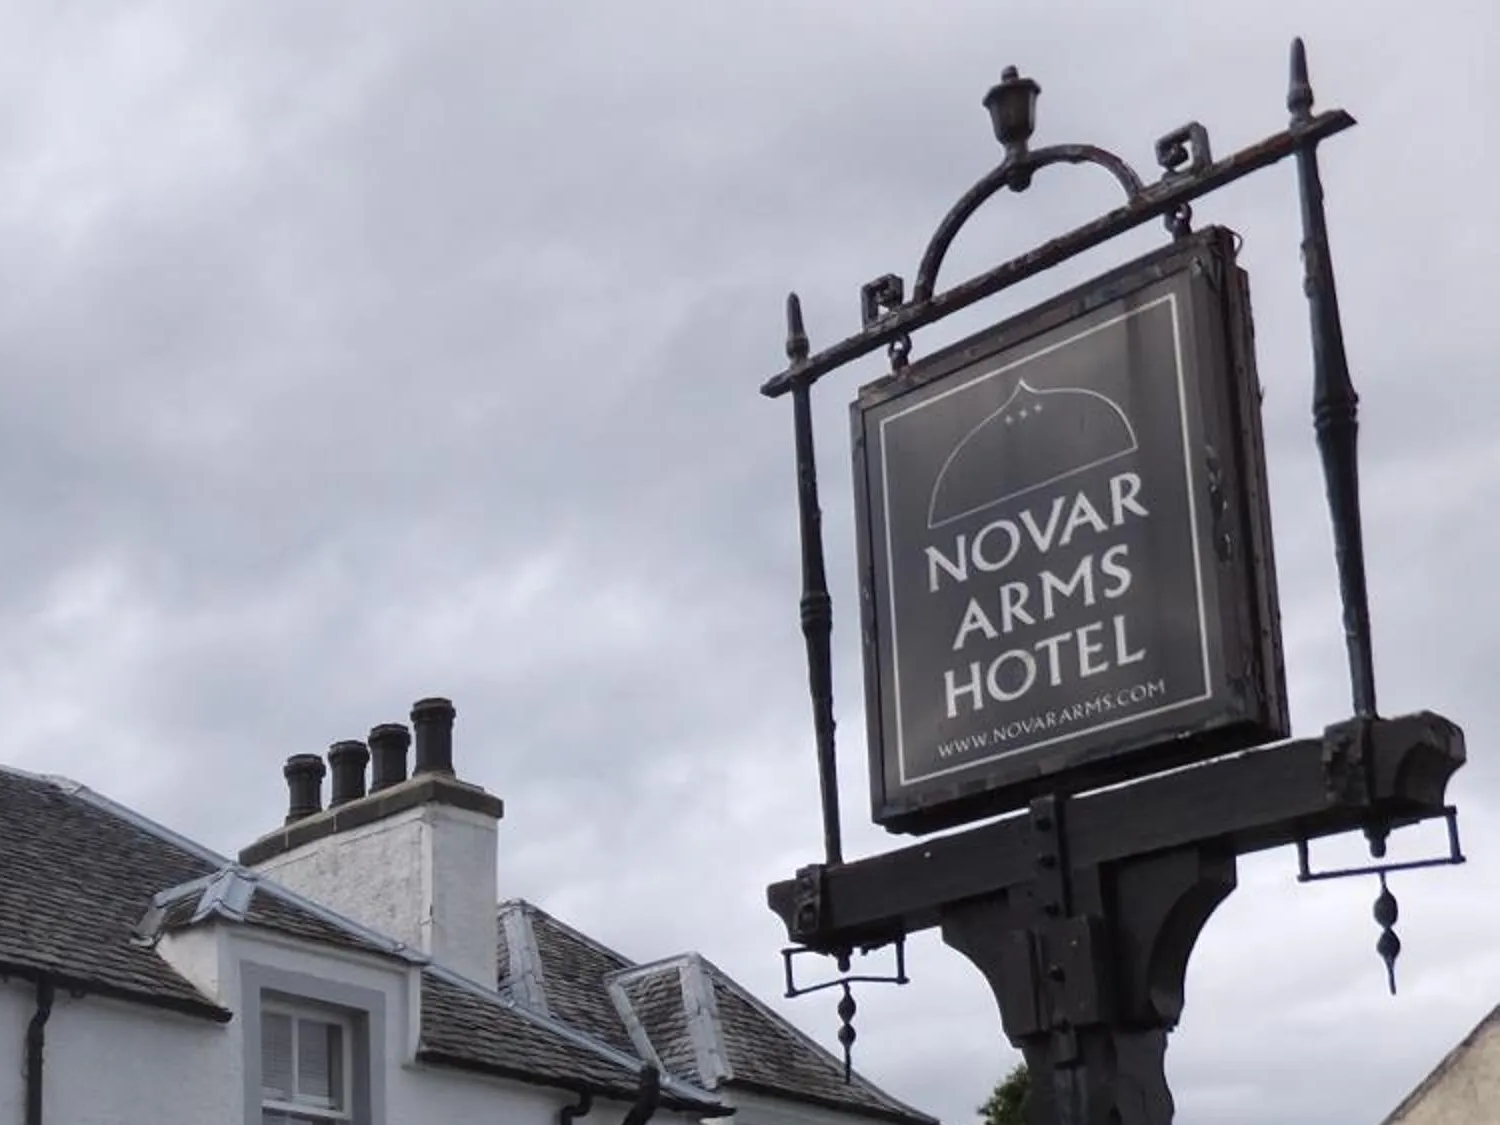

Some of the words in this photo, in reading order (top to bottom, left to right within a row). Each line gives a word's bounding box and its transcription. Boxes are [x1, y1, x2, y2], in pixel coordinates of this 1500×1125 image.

[924, 471, 1149, 593] NOVAR
[952, 543, 1132, 651] ARMS
[943, 614, 1146, 720] HOTEL
